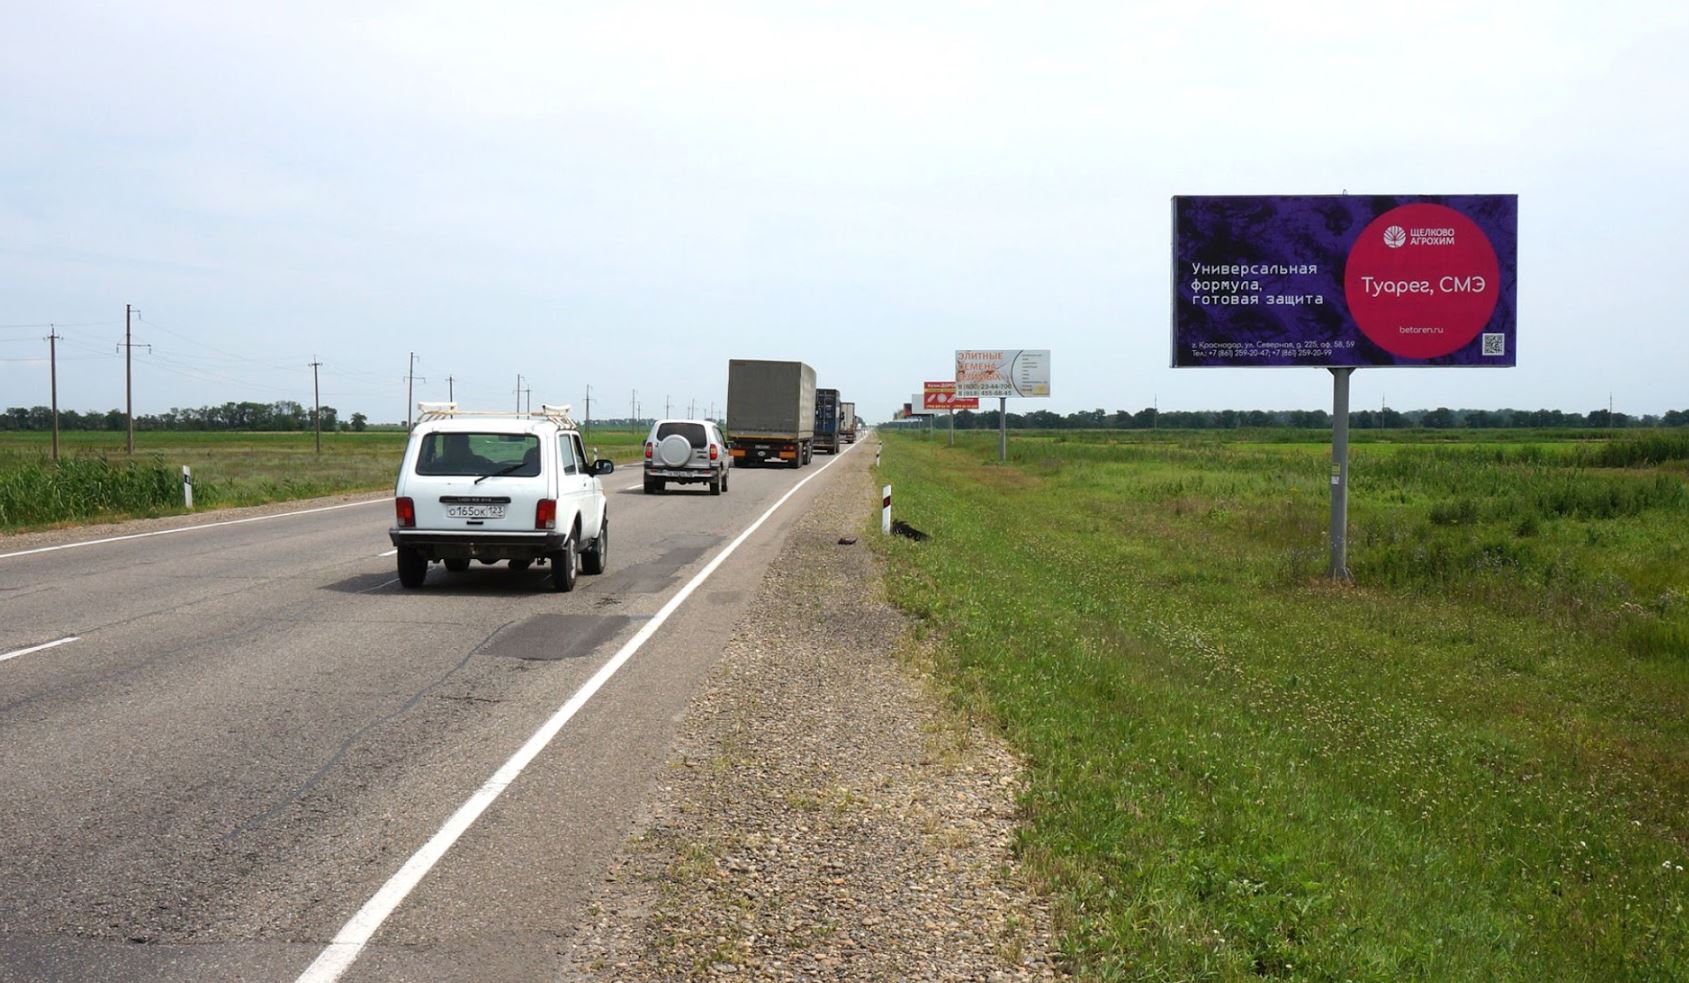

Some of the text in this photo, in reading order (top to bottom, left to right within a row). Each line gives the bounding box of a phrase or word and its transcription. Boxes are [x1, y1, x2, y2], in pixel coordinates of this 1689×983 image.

[1410, 228, 1455, 237] ЩЕЛКОВО
[1410, 237, 1455, 245] АГРОХИМ
[1191, 262, 1318, 277] Универсальная
[1191, 278, 1263, 293] формула,
[1361, 276, 1486, 297] Туарег, СМЭ
[1192, 294, 1324, 306] готовая защита
[1399, 326, 1444, 334] betaren.ru
[1199, 341, 1244, 350] Краснодар,
[1346, 340, 1355, 348] 59
[958, 352, 1004, 360] ЭЛИТНЫЕ
